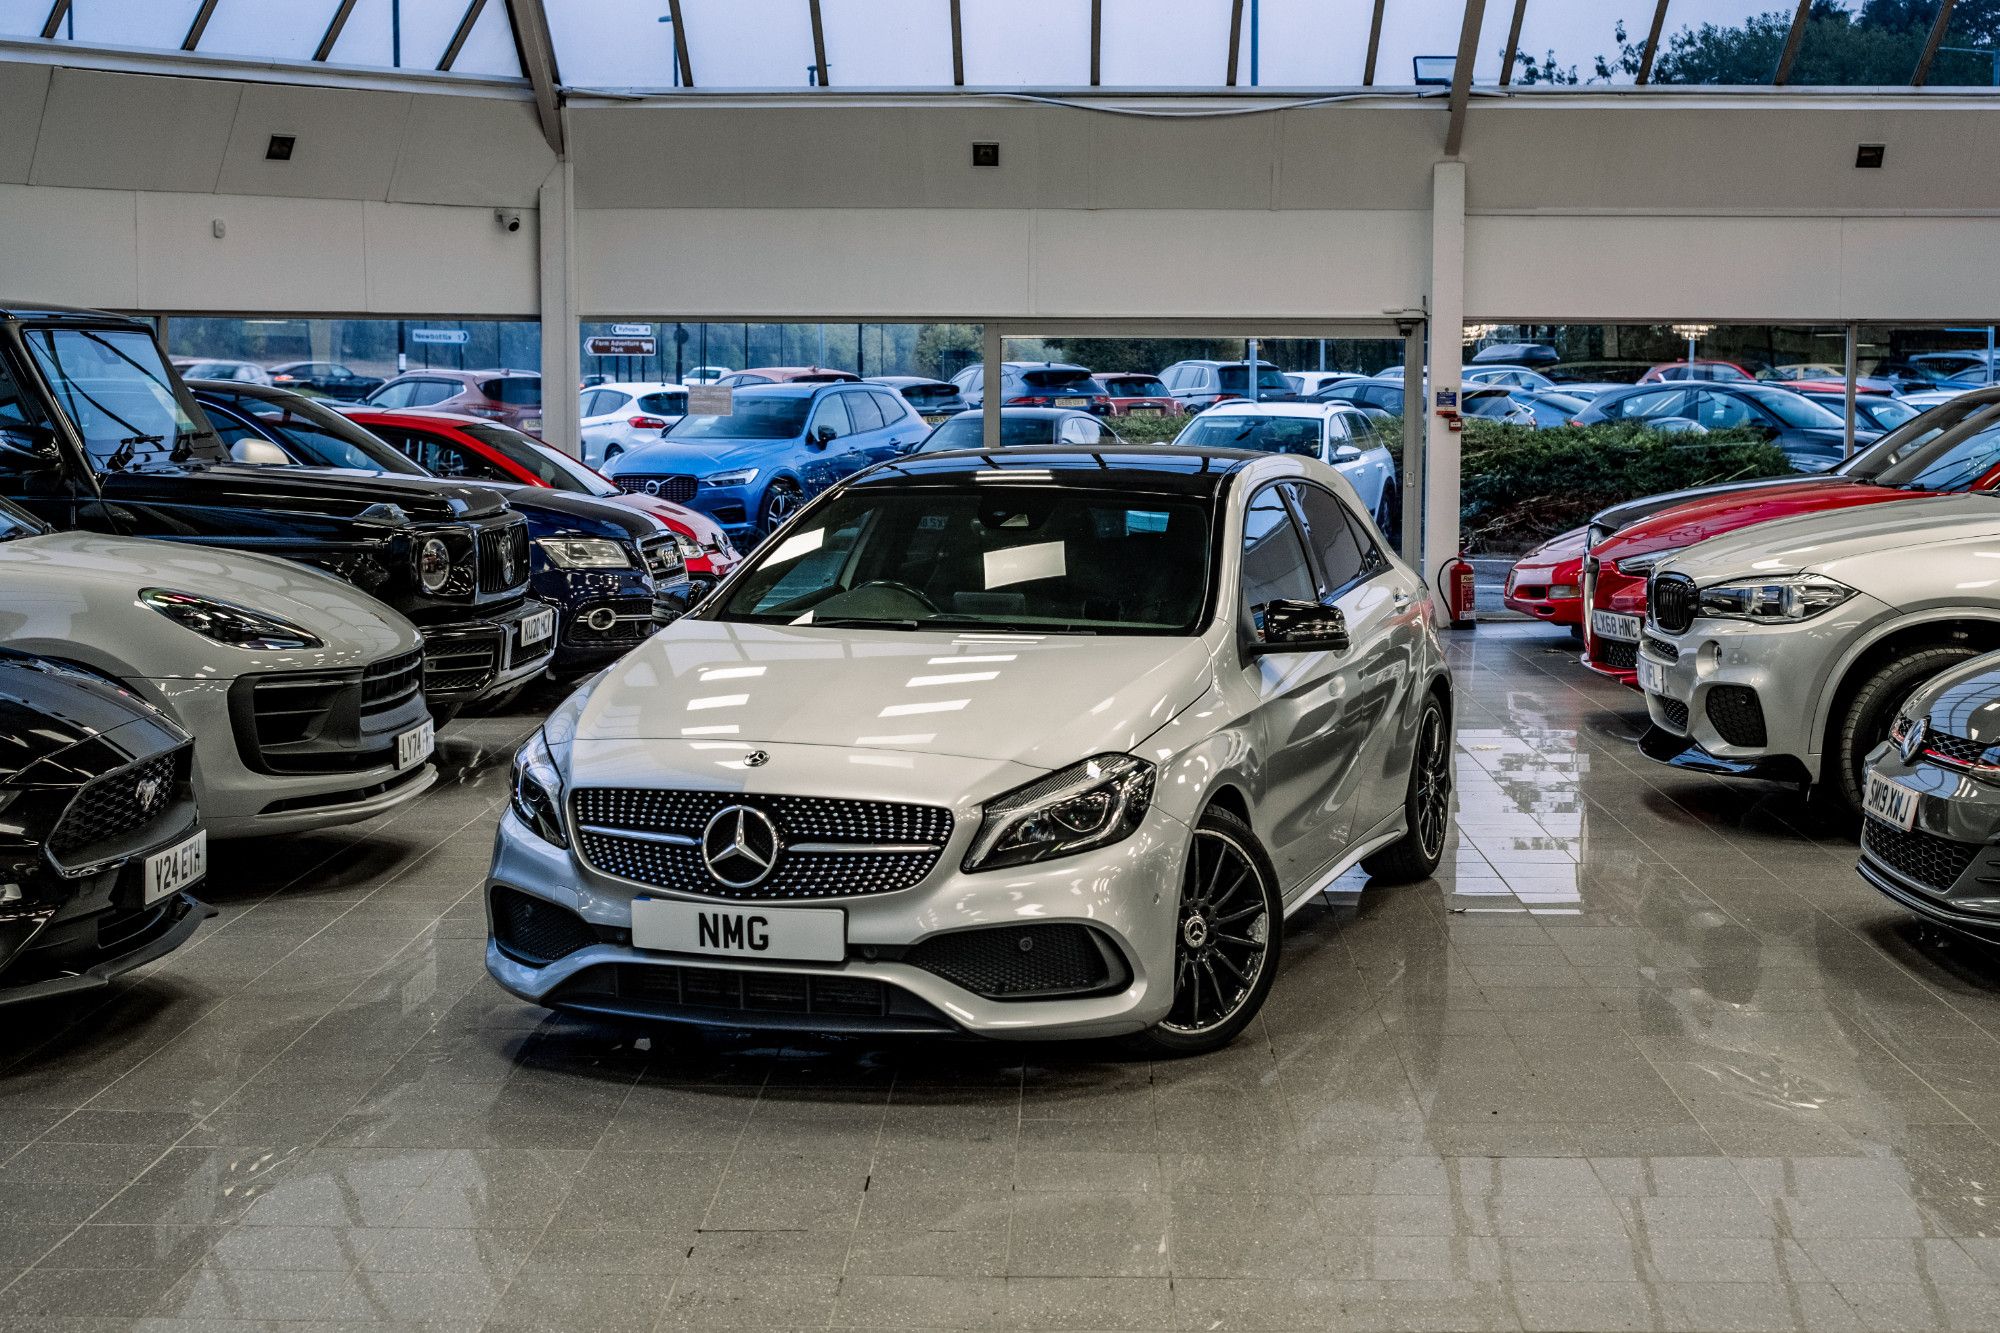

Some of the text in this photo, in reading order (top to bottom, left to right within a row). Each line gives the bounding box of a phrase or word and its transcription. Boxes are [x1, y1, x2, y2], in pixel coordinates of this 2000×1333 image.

[414, 332, 452, 340] Newbottle
[524, 616, 540, 641] KU20
[1595, 612, 1637, 638] LX68 HNC
[402, 731, 421, 763] LY74
[1868, 778, 1911, 823] SM19 XWJ
[156, 838, 200, 893] V24 ETH
[698, 912, 769, 951] NMG
